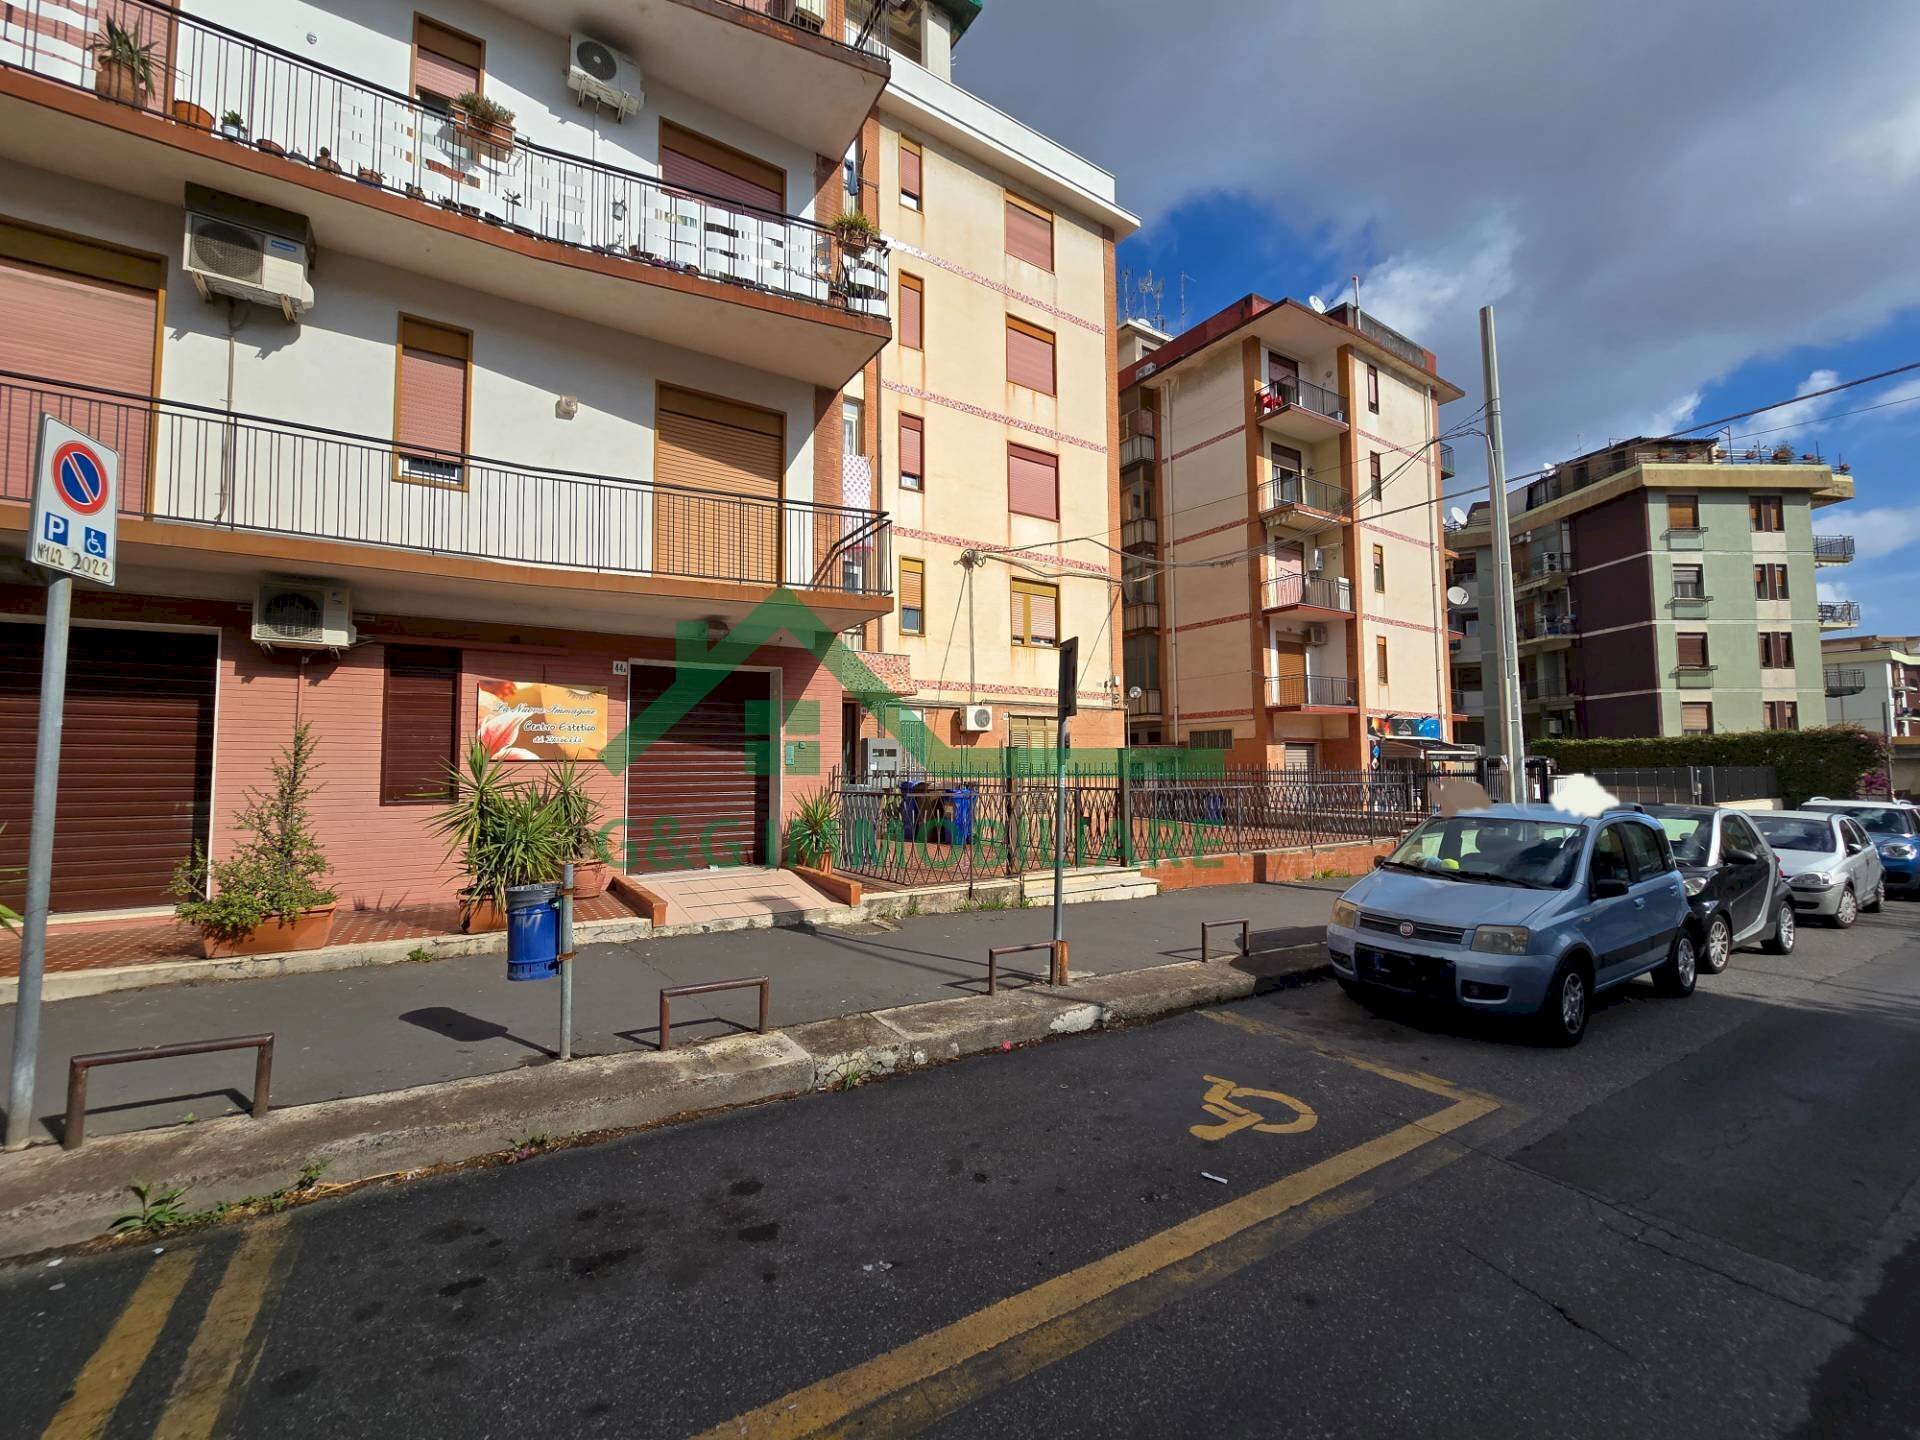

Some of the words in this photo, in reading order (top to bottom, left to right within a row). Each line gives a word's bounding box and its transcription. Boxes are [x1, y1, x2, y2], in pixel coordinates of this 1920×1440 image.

[48, 514, 65, 540] P
[71, 552, 109, 576] 2022
[524, 720, 556, 732] Centro
[559, 722, 596, 732] Estetico
